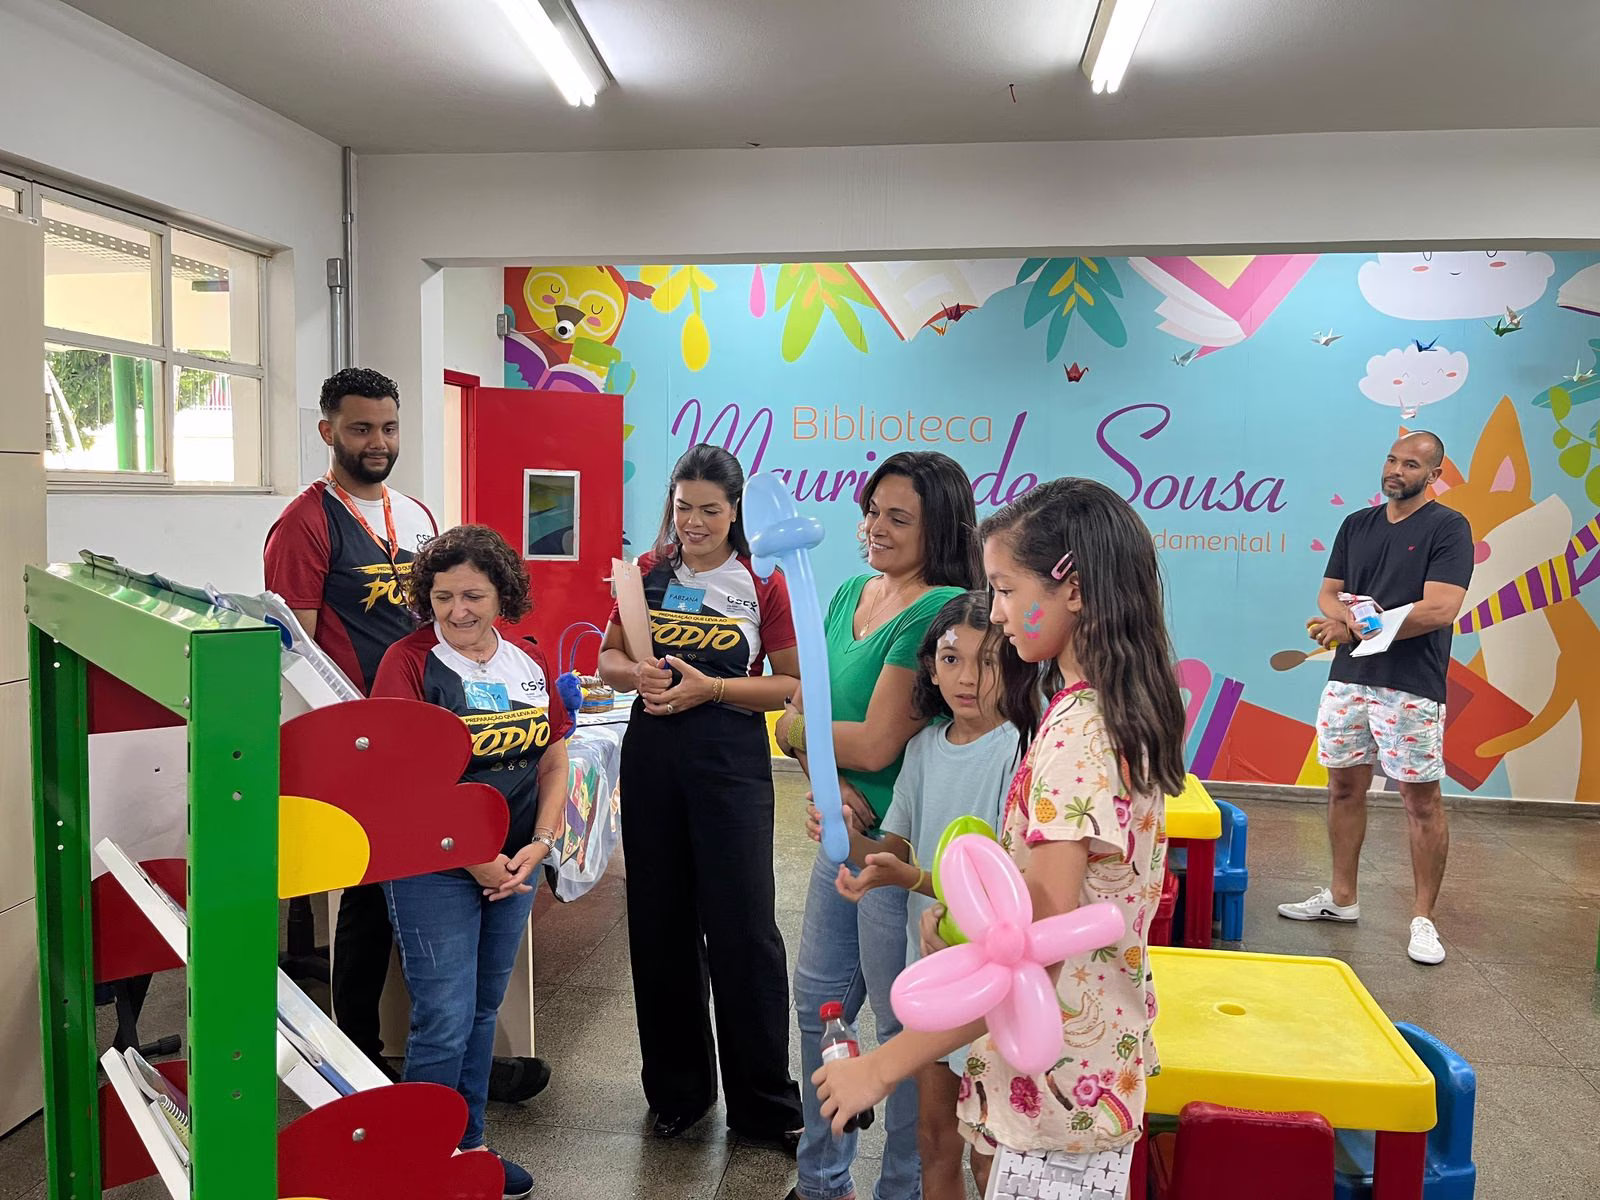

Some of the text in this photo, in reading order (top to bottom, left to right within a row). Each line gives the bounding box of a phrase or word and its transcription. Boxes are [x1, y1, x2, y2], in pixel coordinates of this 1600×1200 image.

[793, 404, 993, 443] Biblioteca
[1096, 403, 1288, 513] Sousa
[1153, 528, 1271, 553] damental
[669, 594, 698, 603] FABIANA
[470, 719, 551, 758] ÓDIO
